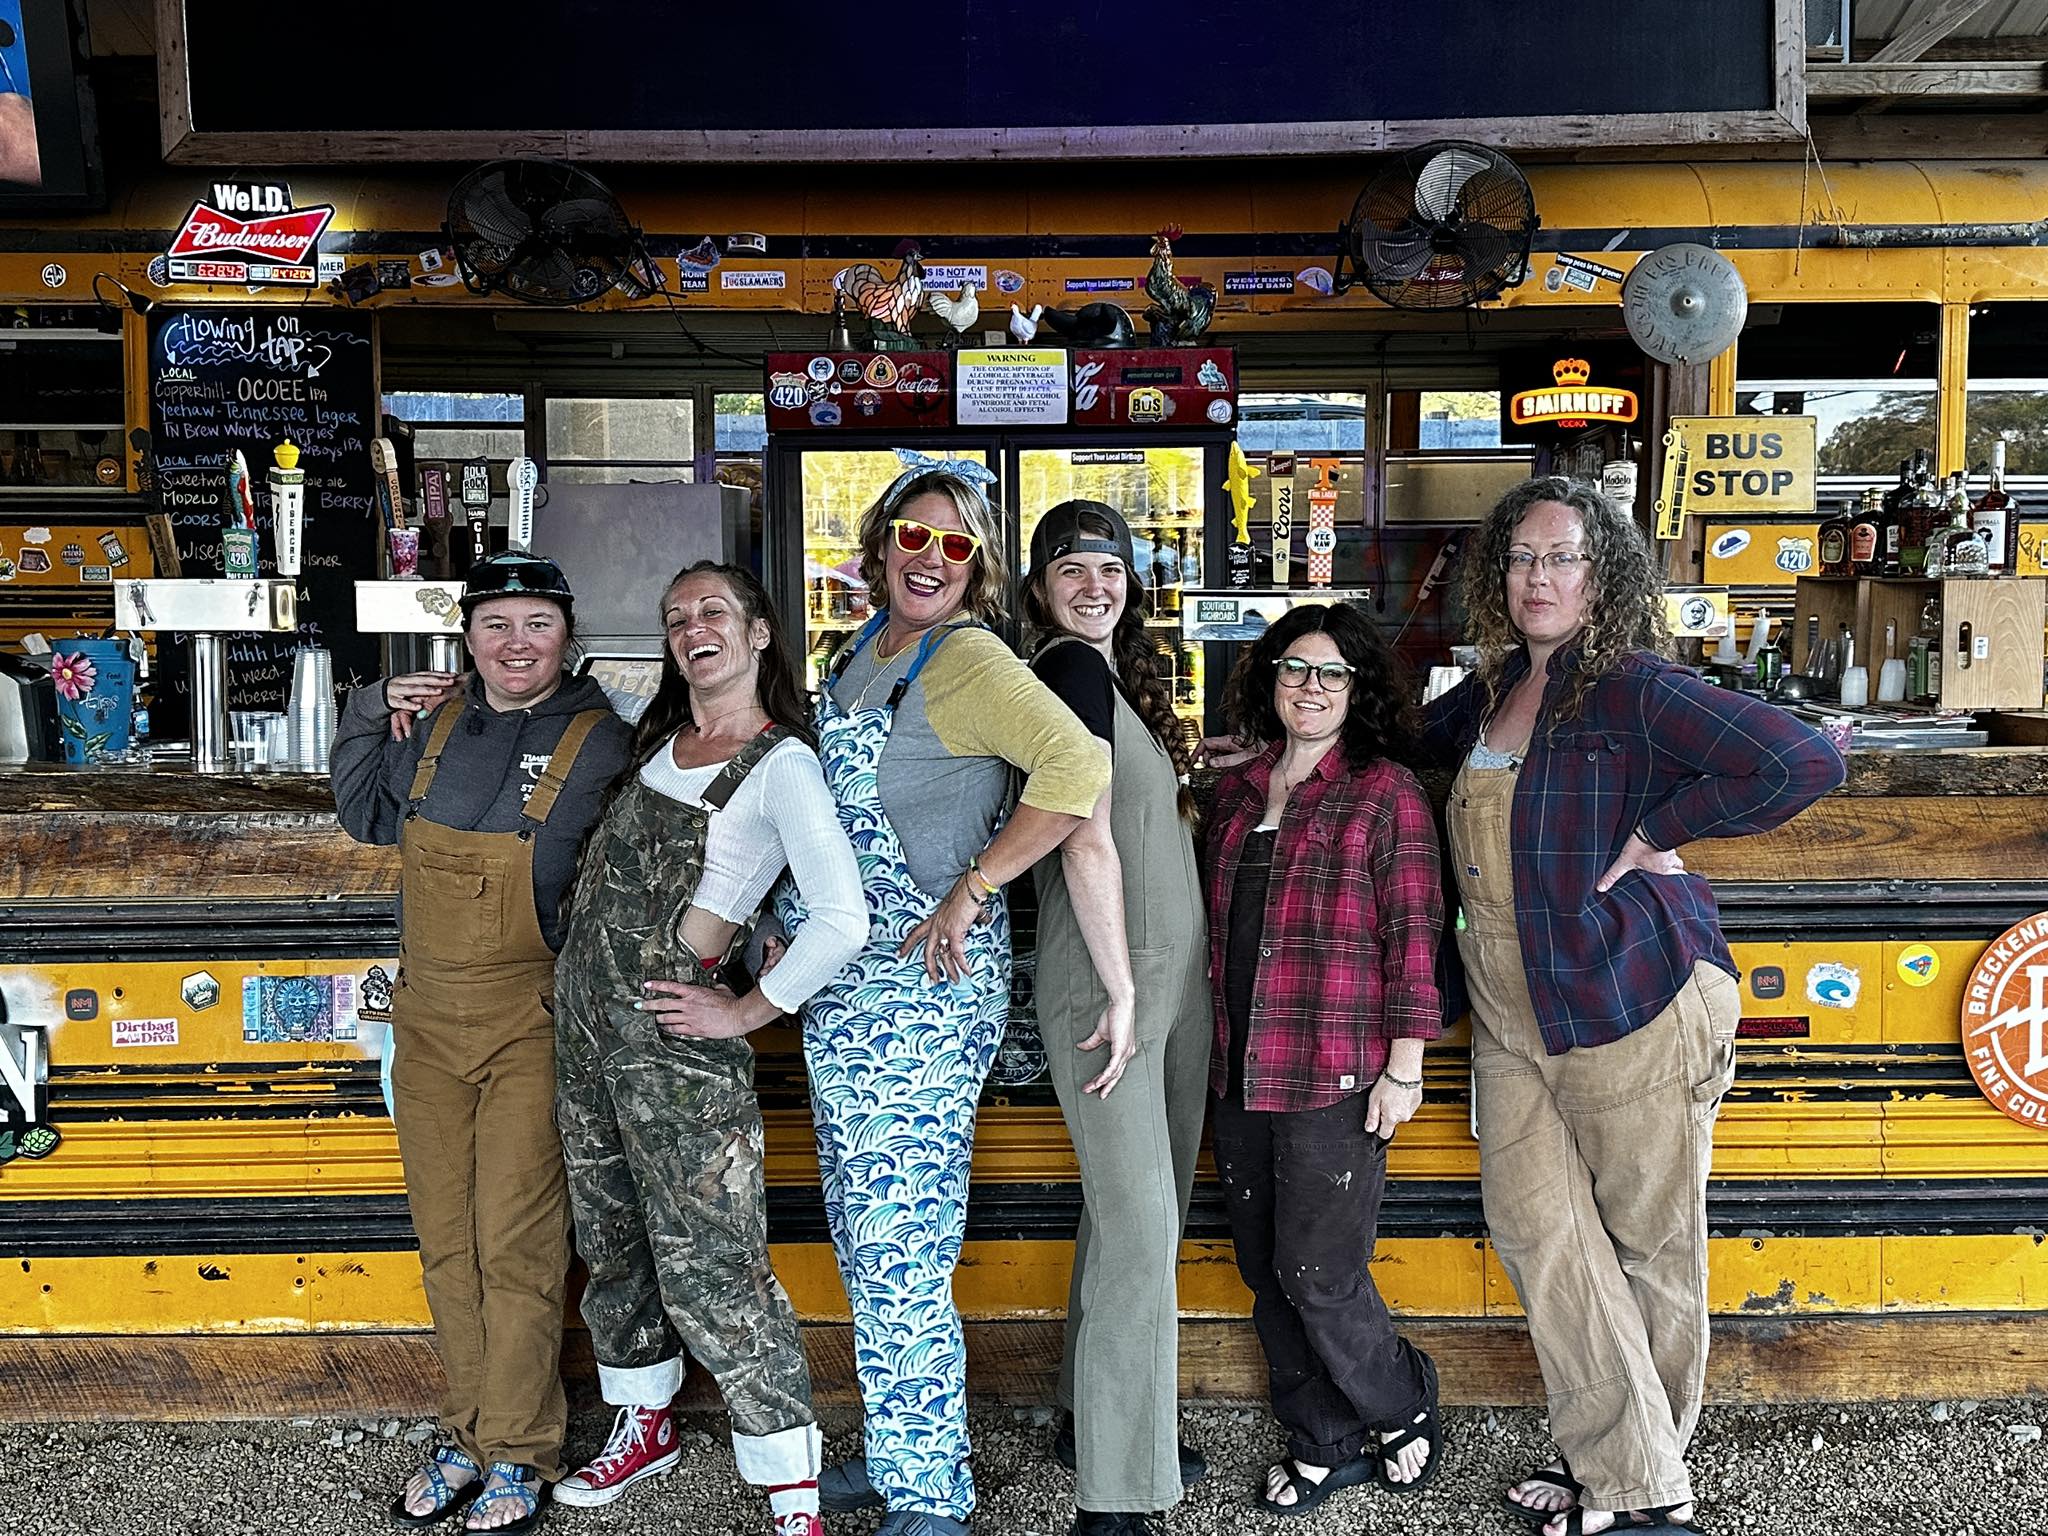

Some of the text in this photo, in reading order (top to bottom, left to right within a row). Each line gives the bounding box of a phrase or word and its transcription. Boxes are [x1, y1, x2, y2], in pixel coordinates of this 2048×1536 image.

[214, 184, 249, 211] We
[187, 221, 310, 249] Budweiser
[319, 260, 344, 271] MER
[681, 271, 707, 279] HOME
[923, 268, 981, 277] IS IS NOT AN
[682, 280, 706, 288] TEAM
[723, 276, 784, 287] JUGSLAMMERS
[920, 279, 954, 289] andoned
[1066, 280, 1086, 289] Support
[1098, 280, 1111, 288] Local
[179, 313, 299, 355] flowing on
[986, 354, 1036, 362] WARNING
[161, 368, 197, 379] LOCAL
[237, 377, 306, 402] OCOEE
[310, 391, 328, 401] IPA
[776, 387, 803, 405] 420
[1133, 398, 1160, 412] BUS
[1523, 392, 1625, 416] SMIRNOFF
[221, 402, 308, 422] Tennessee
[1558, 420, 1588, 428] VODKA
[162, 422, 179, 437] TN
[185, 423, 219, 439] Brew
[224, 423, 271, 440] Works
[343, 438, 363, 451] IPA
[1706, 432, 1783, 460] BUS
[155, 454, 225, 468] LOCAL FAVE
[1072, 453, 1093, 462] Support
[1121, 453, 1144, 461] Dirtbags
[161, 470, 226, 489] Sweetwa
[327, 477, 347, 488] ale
[464, 477, 487, 489] ROCK
[1605, 475, 1631, 485] Modelo
[1693, 470, 1793, 496] STOP
[428, 474, 441, 500] IPA
[1274, 485, 1291, 540] Coors
[288, 491, 297, 564] WISEACRE
[108, 545, 122, 558] 420
[176, 542, 225, 561] WiseA
[230, 553, 247, 566] 420
[1780, 552, 1807, 568] 420
[1201, 602, 1235, 611] SOUTHERN
[1200, 612, 1236, 621] HIGHROADS
[116, 1021, 175, 1034] Dirtbag
[141, 1032, 175, 1043] Diva
[1972, 1046, 2009, 1098] FINE
[455, 1453, 474, 1468] NRS
[437, 1484, 447, 1508] NRS
[495, 1487, 519, 1496] NRS
